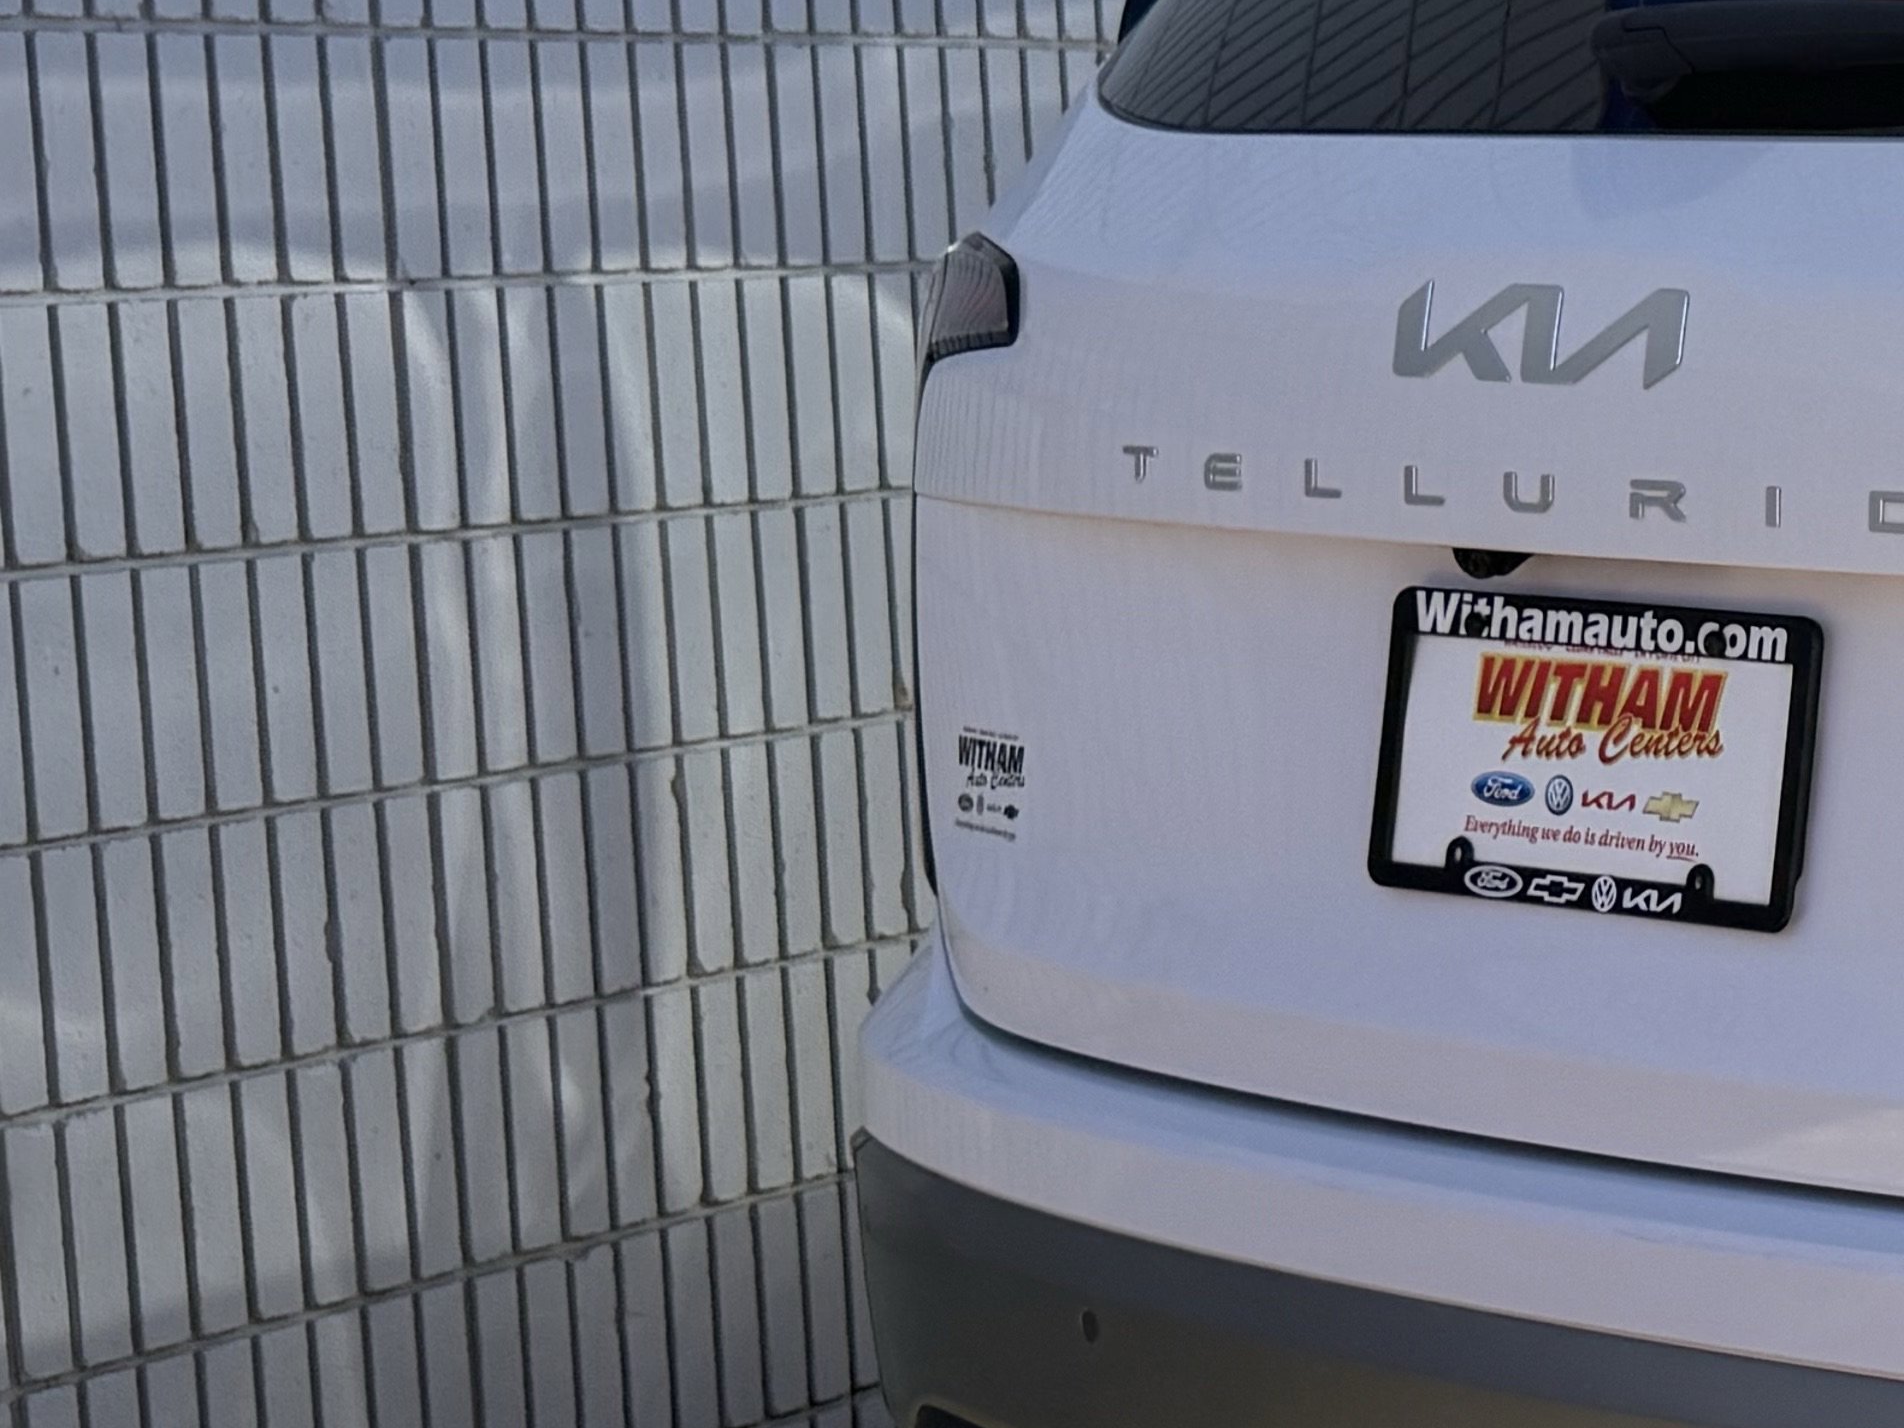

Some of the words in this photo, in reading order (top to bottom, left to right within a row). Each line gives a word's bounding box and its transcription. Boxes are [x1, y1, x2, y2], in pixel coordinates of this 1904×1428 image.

[1391, 278, 1690, 391] KIA
[1473, 653, 1727, 732] WITHAM
[958, 733, 1025, 774] WITHAM
[1502, 716, 1586, 761] Auto
[1598, 714, 1723, 765] Centers
[1464, 814, 1539, 845] Everything
[1541, 825, 1561, 842] we
[1563, 824, 1582, 844] do
[1584, 826, 1597, 846] is
[1598, 828, 1646, 852] driven
[1648, 834, 1667, 858] by
[1667, 840, 1700, 861] you.
